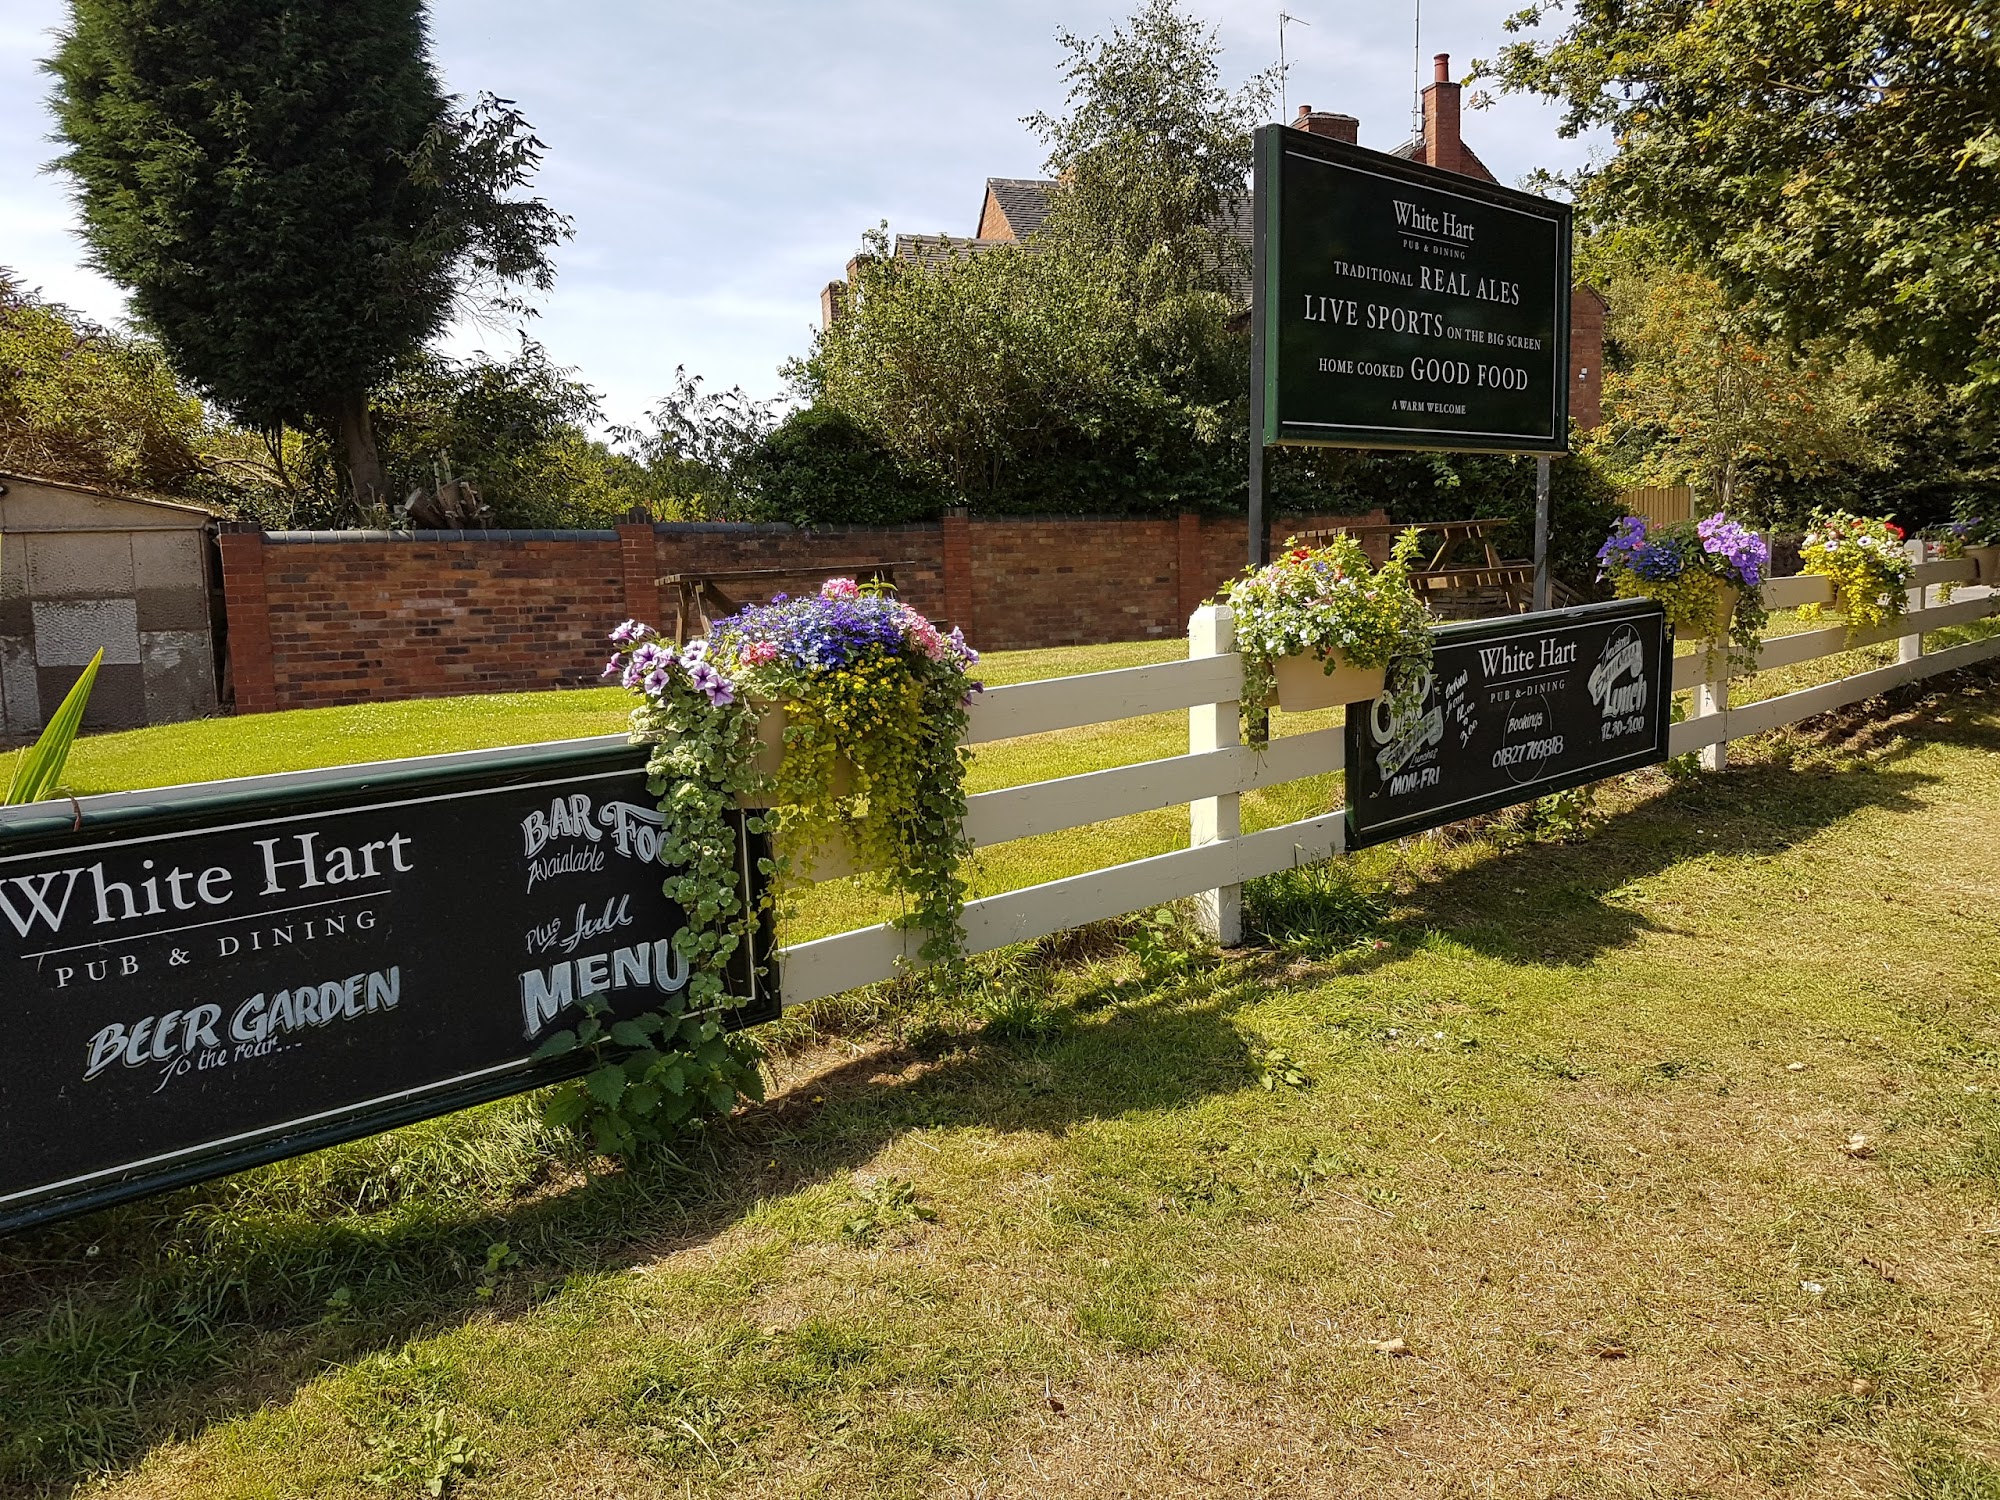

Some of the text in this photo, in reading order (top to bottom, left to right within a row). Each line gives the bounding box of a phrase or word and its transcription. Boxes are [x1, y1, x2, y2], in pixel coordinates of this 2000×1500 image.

[1393, 199, 1475, 241] White Hart
[1403, 239, 1466, 260] PUB & DINING
[1333, 260, 1519, 306] TRADITIONAL REAL ALES
[1304, 294, 1542, 351] LIVE SPORTS ON THE BIG SCREEN
[1318, 356, 1528, 391] HOME COOKED GOOD FOOD
[1391, 400, 1467, 415] A WARM WELCOME
[1478, 638, 1578, 679] White Hart
[1445, 691, 1465, 723] from
[1490, 690, 1510, 703] PUB
[1527, 679, 1566, 697] DINING
[1602, 673, 1648, 718] Lunch
[1492, 735, 1564, 768] 01827 769818
[1389, 765, 1441, 797] MON-FRI
[521, 793, 603, 860] BAR
[0, 831, 415, 939] White Hart
[525, 894, 634, 954] Plus full
[55, 910, 377, 989] PUB & DINING
[520, 938, 690, 1041] MENU
[82, 964, 401, 1082] BEER GARDEN
[198, 1045, 227, 1070] the
